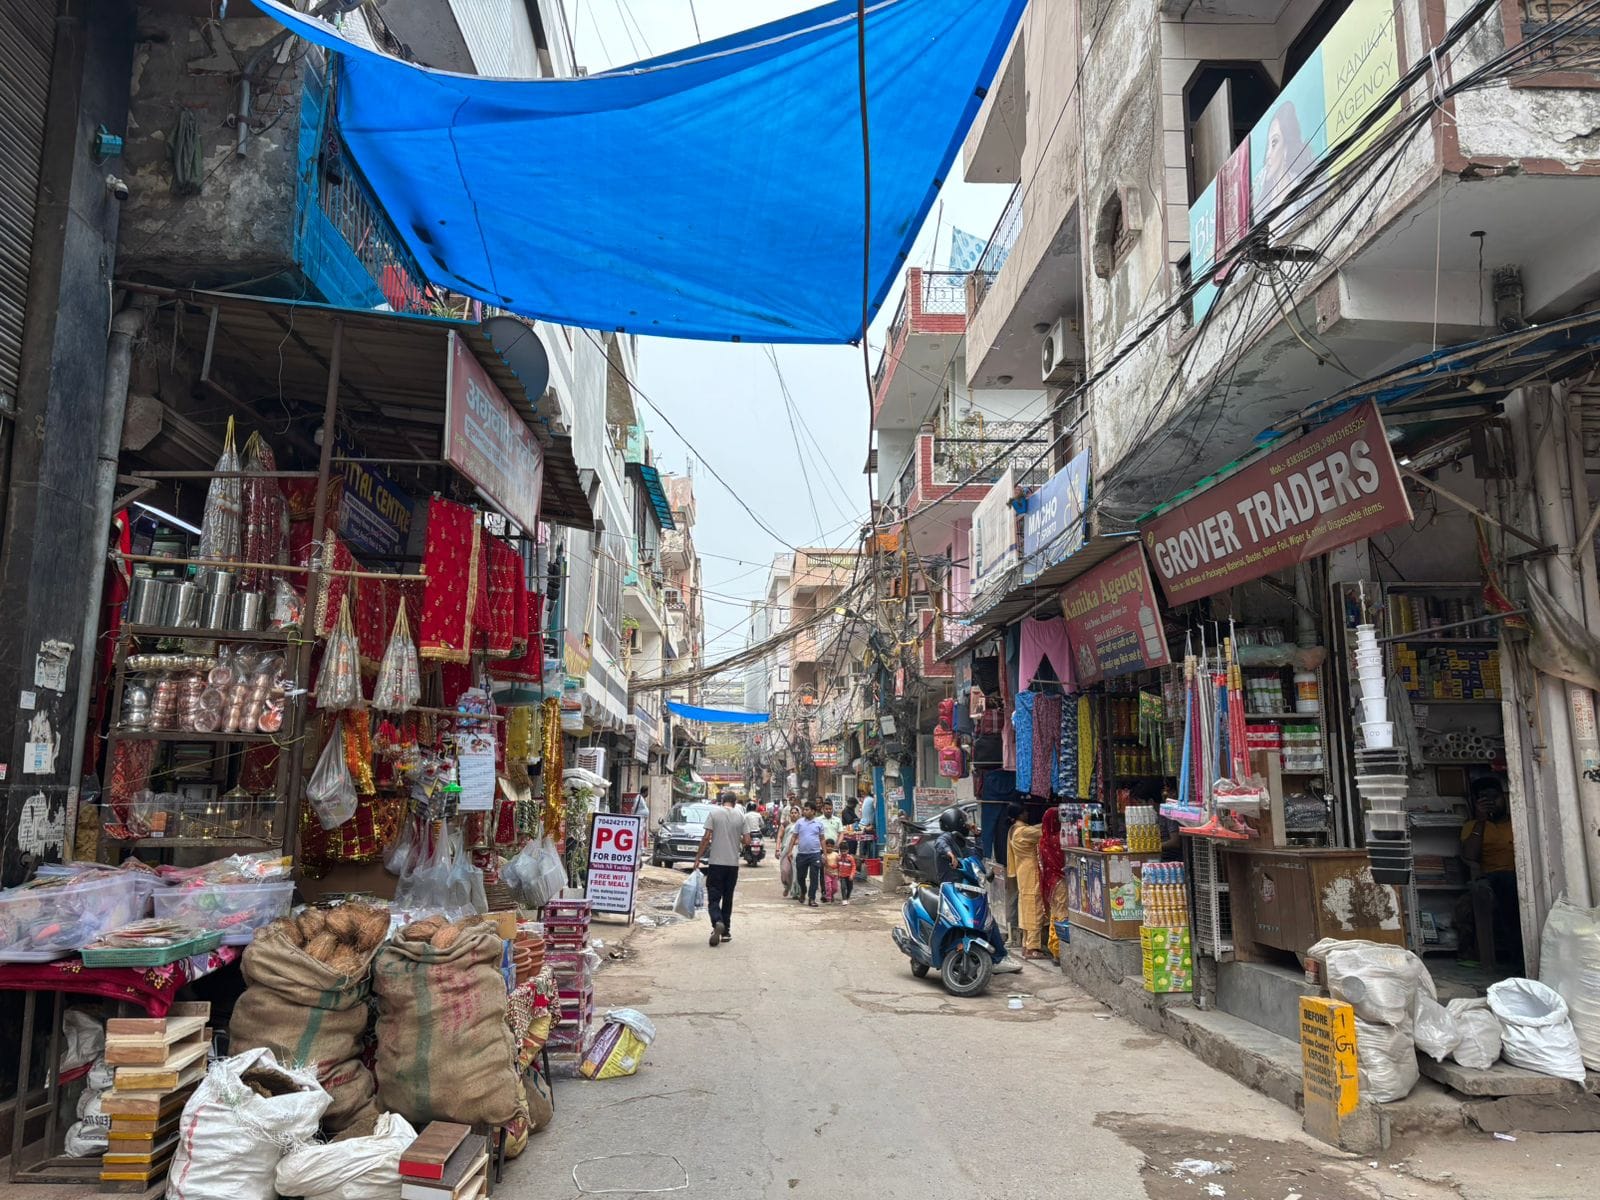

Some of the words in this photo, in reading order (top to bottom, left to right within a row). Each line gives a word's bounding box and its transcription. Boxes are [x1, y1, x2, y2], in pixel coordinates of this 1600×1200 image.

[1336, 23, 1393, 91] KANIKA
[1335, 56, 1394, 132] AGENCY
[376, 485, 411, 533] CENTRE
[1154, 510, 1242, 579] GROVER
[1237, 439, 1380, 543] TRADERS
[1288, 531, 1306, 547] Wiper
[1326, 509, 1362, 531] Disposable
[1361, 499, 1385, 517] items.
[1062, 590, 1100, 621] Kanika
[1101, 566, 1143, 604] Agency
[595, 827, 633, 852] PG
[598, 818, 636, 826] 7042421717
[593, 852, 609, 861] FOR
[611, 854, 632, 862] BOYS
[590, 879, 606, 887] FREE
[1304, 1009, 1328, 1025] BEFORE
